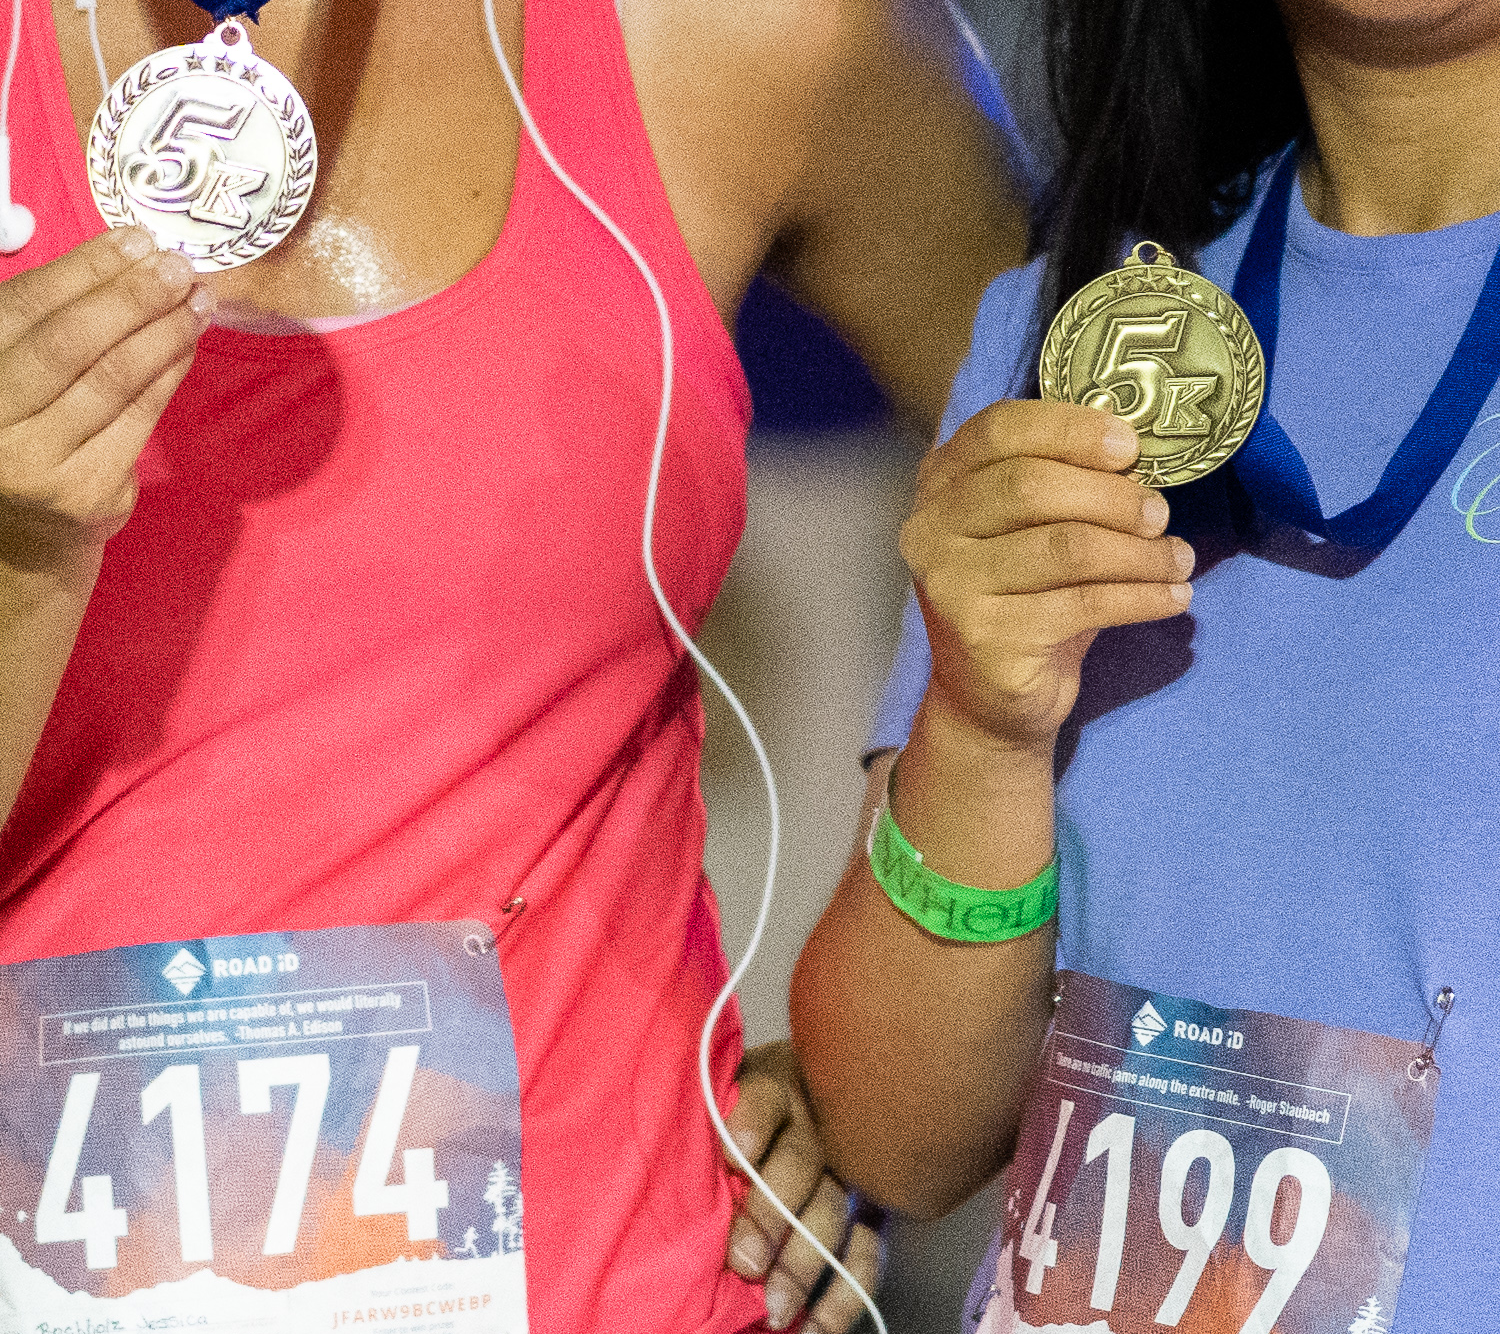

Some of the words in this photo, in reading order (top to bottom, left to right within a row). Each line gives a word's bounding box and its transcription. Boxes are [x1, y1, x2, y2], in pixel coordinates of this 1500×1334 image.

[121, 96, 269, 230] 5K
[1082, 309, 1218, 436] 5K
[211, 954, 273, 978] ROAD
[73, 1021, 89, 1033] we
[90, 1016, 108, 1032] did
[109, 1015, 125, 1030] all
[126, 1012, 146, 1028] the
[147, 1009, 185, 1031] things
[186, 1009, 204, 1023] we
[206, 1007, 226, 1021] are
[228, 1002, 276, 1022] capable
[296, 1001, 314, 1014] we
[316, 994, 353, 1012] would
[354, 989, 402, 1013] literally
[117, 1033, 165, 1051] astound
[165, 1026, 228, 1048] ourselves.
[286, 1021, 300, 1036] A.
[302, 1016, 343, 1035] Edison
[1172, 1019, 1224, 1045] ROAD
[1111, 1068, 1137, 1087] jams
[1137, 1071, 1169, 1094] along
[1169, 1079, 1187, 1095] the
[1188, 1082, 1216, 1101] extra
[1216, 1087, 1242, 1106] mile.
[1278, 1099, 1331, 1124] Staubach
[35, 1045, 450, 1271] 4174
